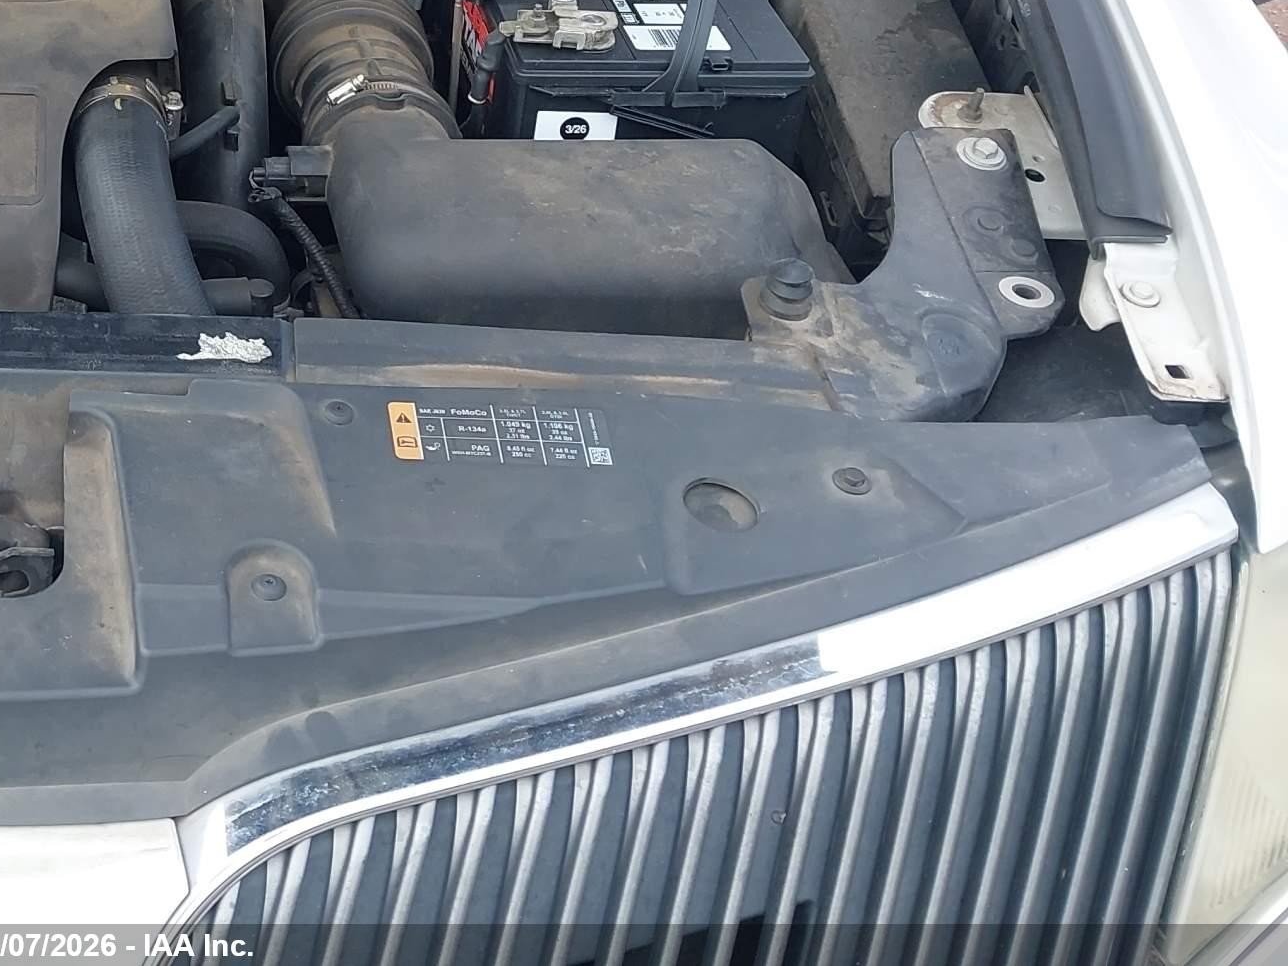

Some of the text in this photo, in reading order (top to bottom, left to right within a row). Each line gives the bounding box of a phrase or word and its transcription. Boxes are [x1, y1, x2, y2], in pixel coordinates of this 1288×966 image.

[565, 124, 587, 134] 3/26
[450, 408, 487, 416] FoMoCo
[458, 425, 487, 433] R-134a
[521, 422, 531, 430] kg
[564, 423, 574, 431] kg
[471, 444, 490, 452] PAG
